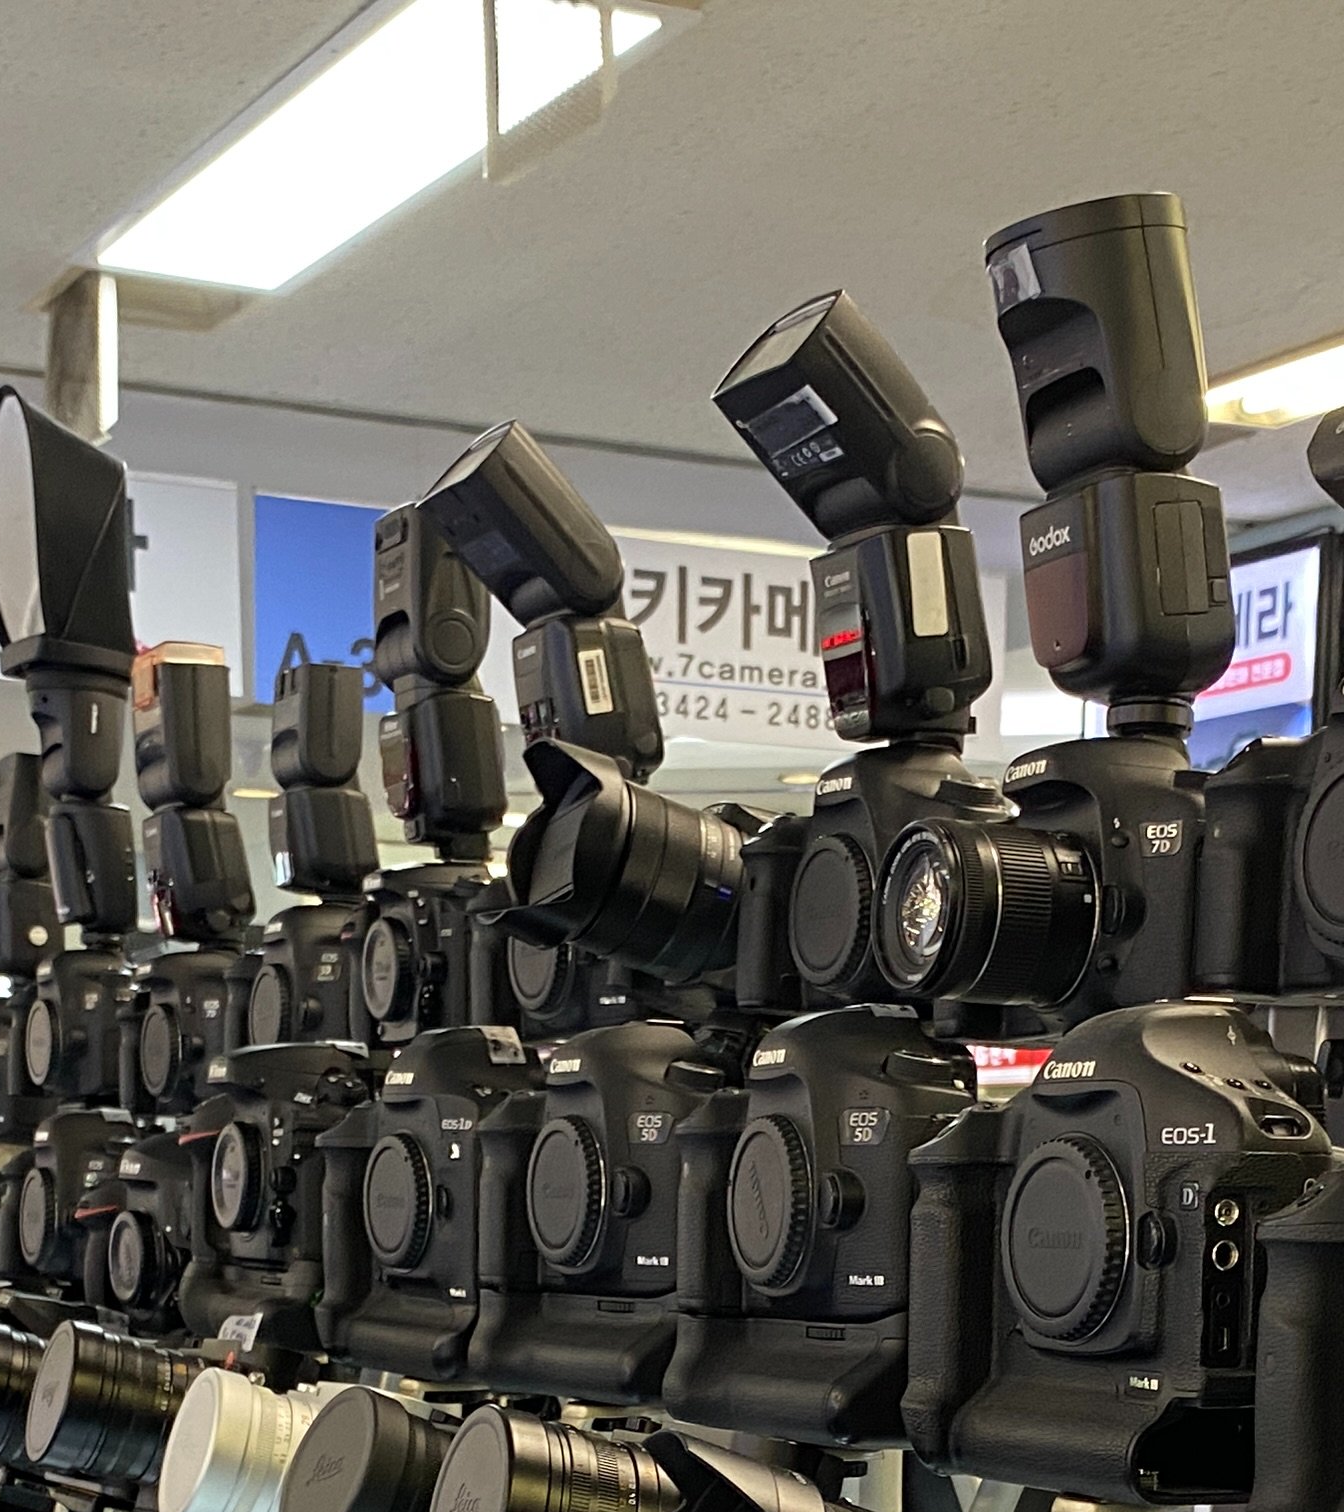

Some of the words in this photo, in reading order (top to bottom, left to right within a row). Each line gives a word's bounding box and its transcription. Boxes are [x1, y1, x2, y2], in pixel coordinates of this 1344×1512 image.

[1029, 525, 1071, 556] Godox
[1005, 759, 1047, 784] Canon
[816, 776, 852, 796] Canon
[1146, 823, 1178, 839] EOS
[1151, 840, 1171, 853] 7D
[550, 1058, 581, 1074] Canon
[753, 1049, 786, 1067] Canon
[1043, 1059, 1096, 1080] Canon
[385, 1070, 414, 1086] Canon
[637, 1114, 662, 1128] EOS
[849, 1112, 878, 1127] EOS
[640, 1128, 658, 1142] 5D
[854, 1127, 872, 1142] 5D
[1161, 1123, 1217, 1145] EOS-1
[1182, 1187, 1194, 1206] D
[849, 1275, 873, 1287] Mark
